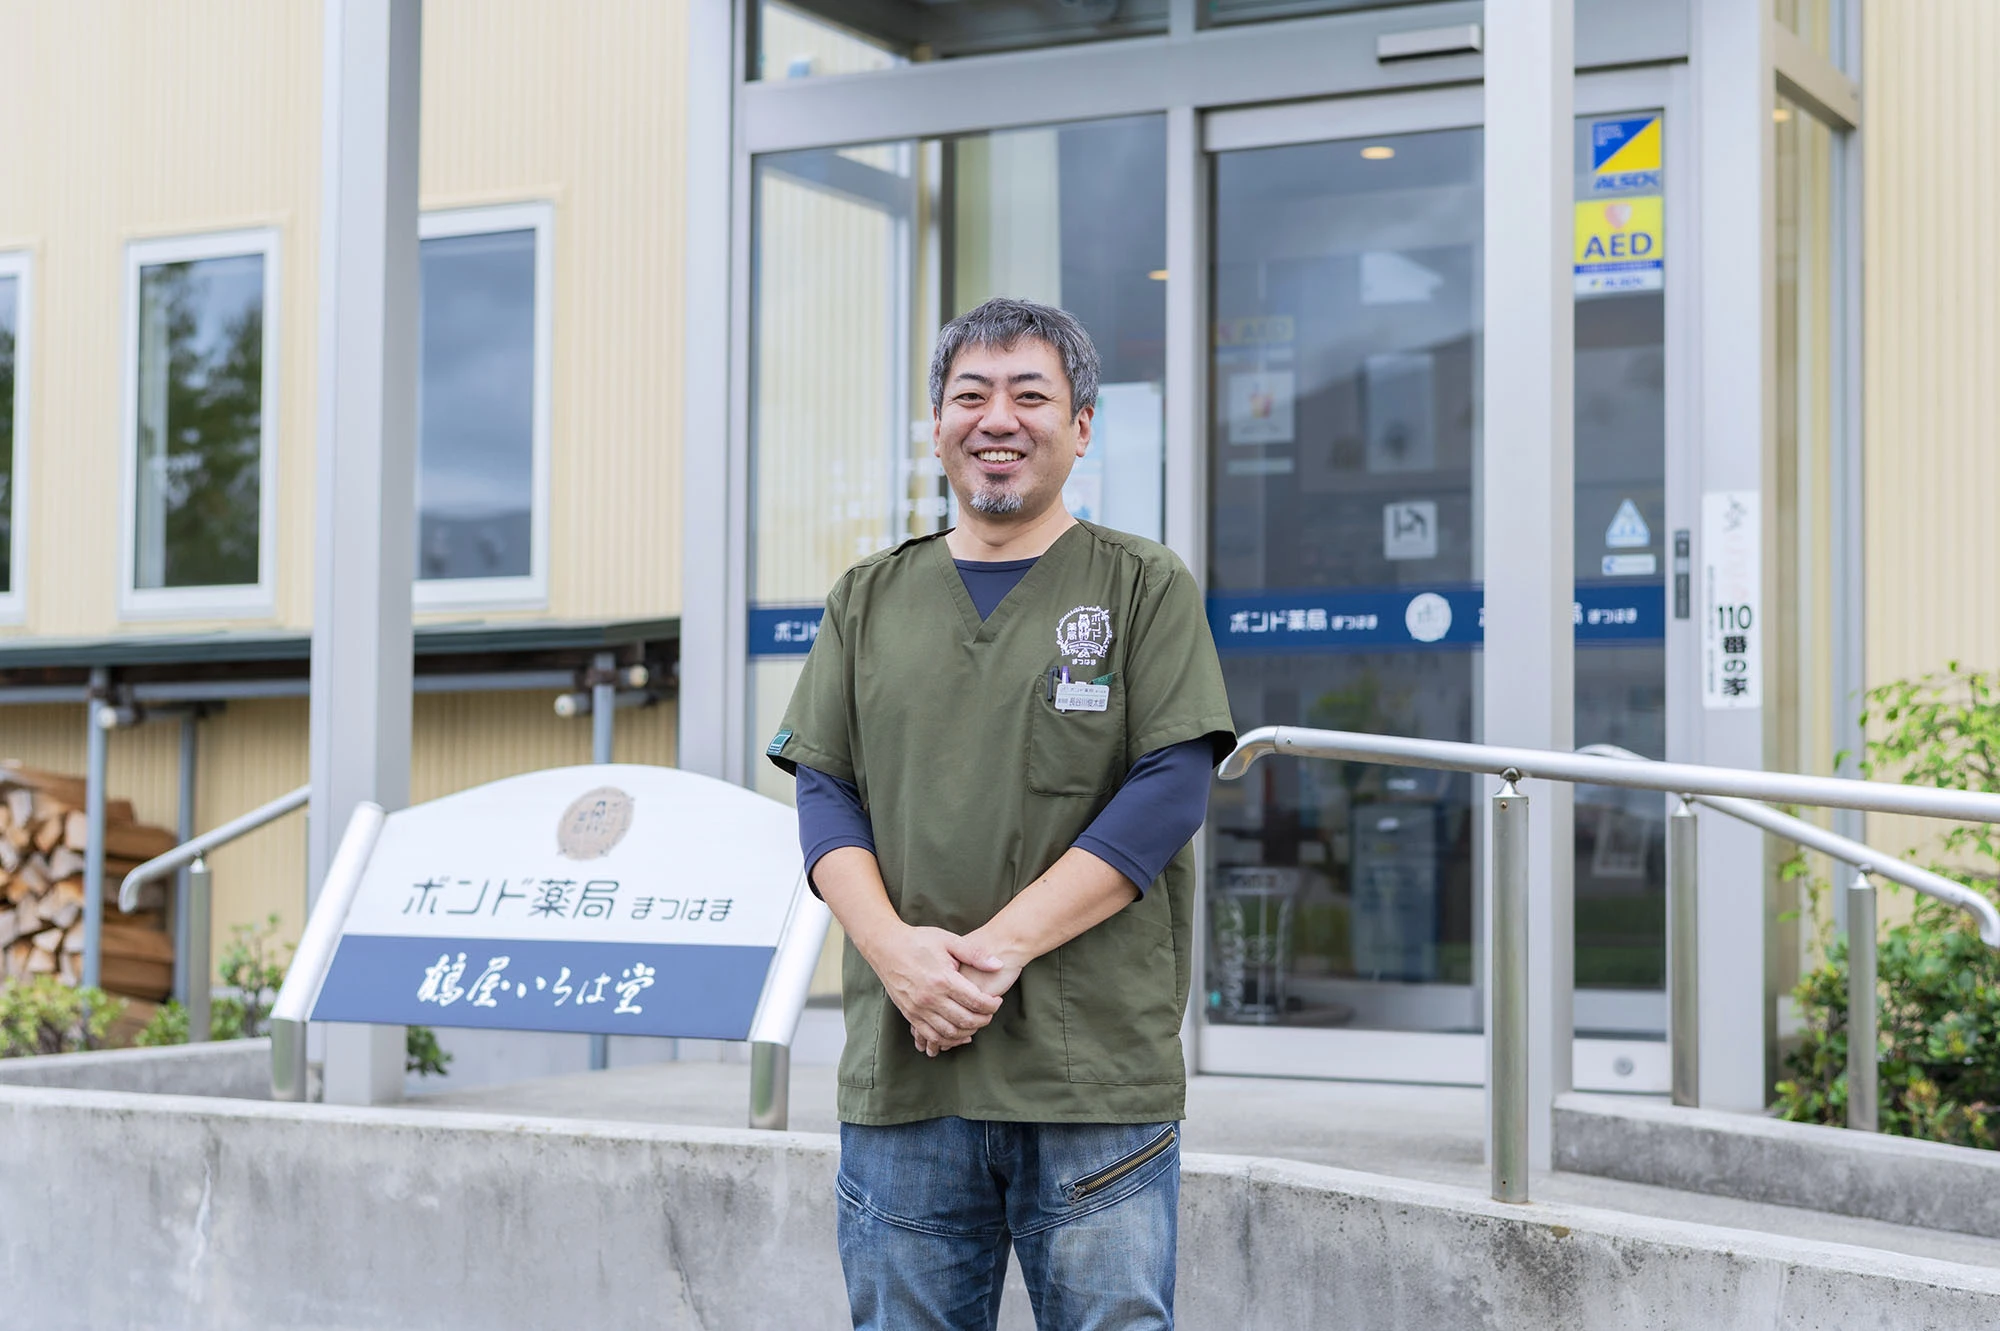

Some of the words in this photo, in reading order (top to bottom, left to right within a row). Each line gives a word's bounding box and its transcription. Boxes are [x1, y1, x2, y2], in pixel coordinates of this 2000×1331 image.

[1583, 232, 1654, 259] AED
[1091, 613, 1101, 641] ボンド
[1230, 608, 1328, 633] ボンド薬局
[1717, 605, 1752, 696] 110番の家
[402, 876, 620, 919] ボンド薬局
[630, 896, 734, 922] まつはま
